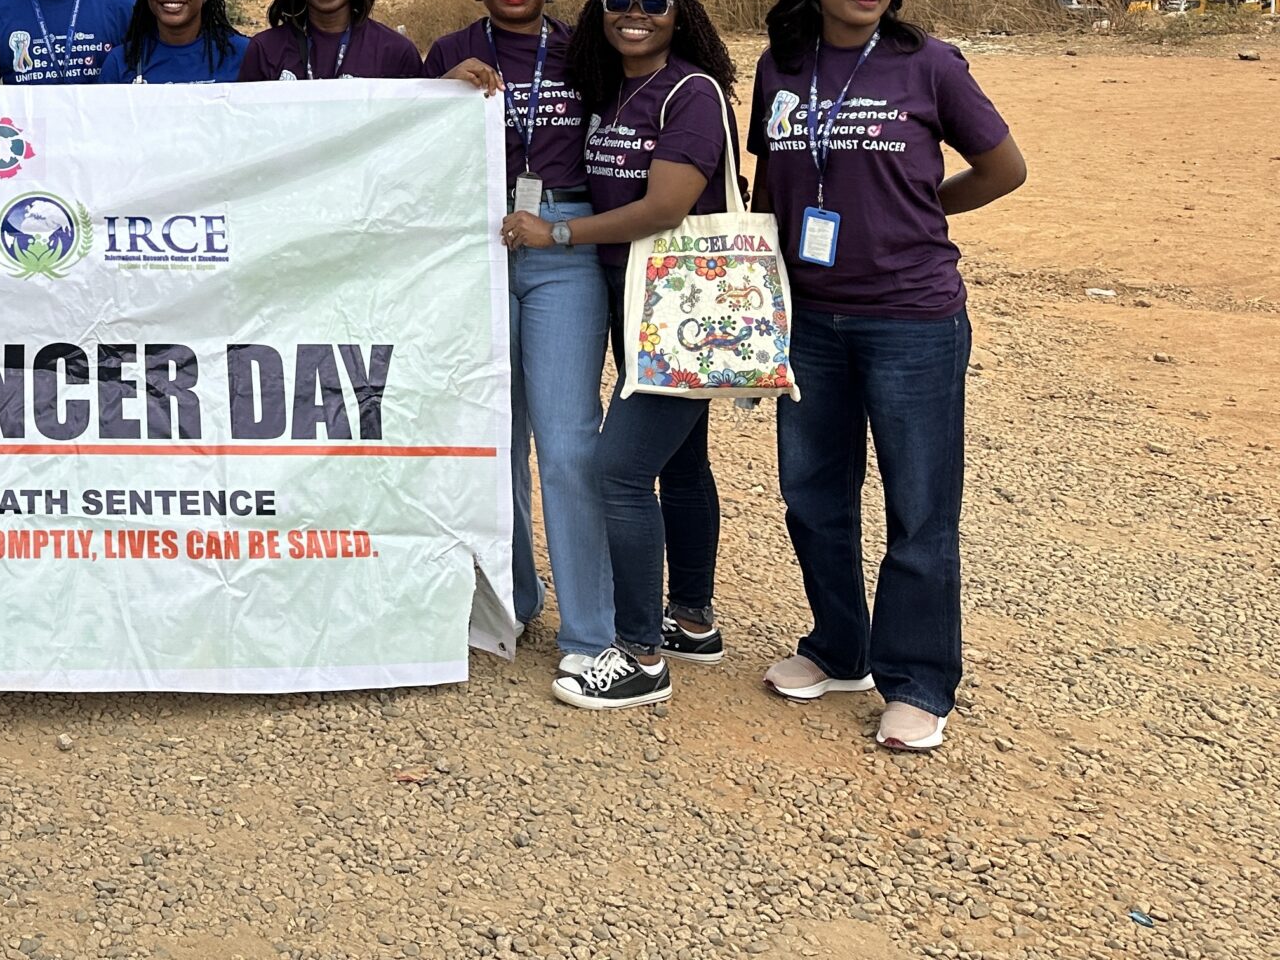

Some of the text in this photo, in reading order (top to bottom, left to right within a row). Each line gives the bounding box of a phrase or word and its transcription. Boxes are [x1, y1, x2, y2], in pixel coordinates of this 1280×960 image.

[32, 42, 102, 55] Ge Sceened
[34, 59, 47, 68] Be
[15, 72, 43, 83] UNITED
[796, 109, 898, 120] Gt creened
[794, 124, 808, 136] Be
[589, 135, 603, 146] Get
[770, 141, 806, 151] UNITED
[862, 140, 906, 152] CANCER
[614, 168, 650, 179] CANCE
[103, 215, 229, 254] IRCE
[651, 234, 773, 254] BARCELONA
[226, 343, 394, 440] DAY
[81, 489, 276, 516] SENTENCE
[104, 529, 179, 559] LIVES
[186, 530, 240, 560] CAN
[248, 530, 281, 559] BE
[288, 530, 379, 559] SAVED.
